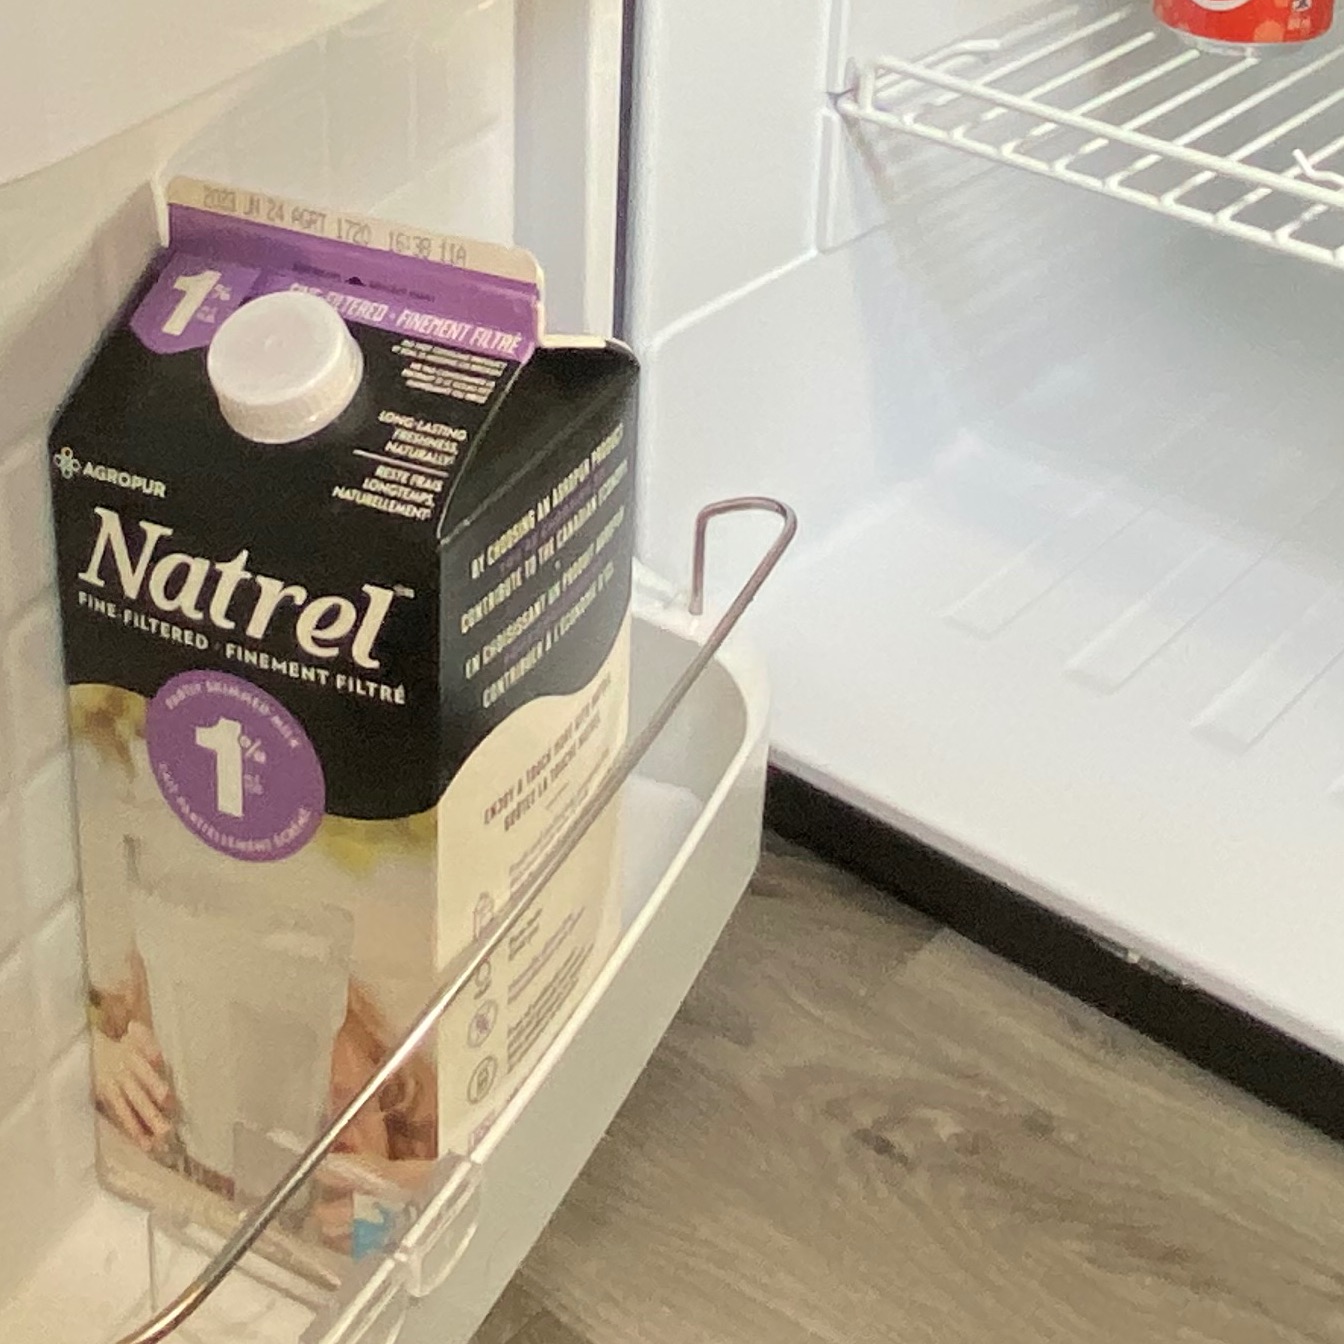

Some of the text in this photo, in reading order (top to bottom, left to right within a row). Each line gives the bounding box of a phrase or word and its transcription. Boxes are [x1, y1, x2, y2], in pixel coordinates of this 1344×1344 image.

[266, 196, 285, 223] 24
[396, 309, 469, 341] FINEMENT
[468, 325, 523, 354] FILTRÉ
[82, 461, 167, 498] AGROPUR
[77, 505, 394, 670] Natrel
[225, 642, 330, 685] FINEMENT
[336, 673, 406, 706] FILTRÉ
